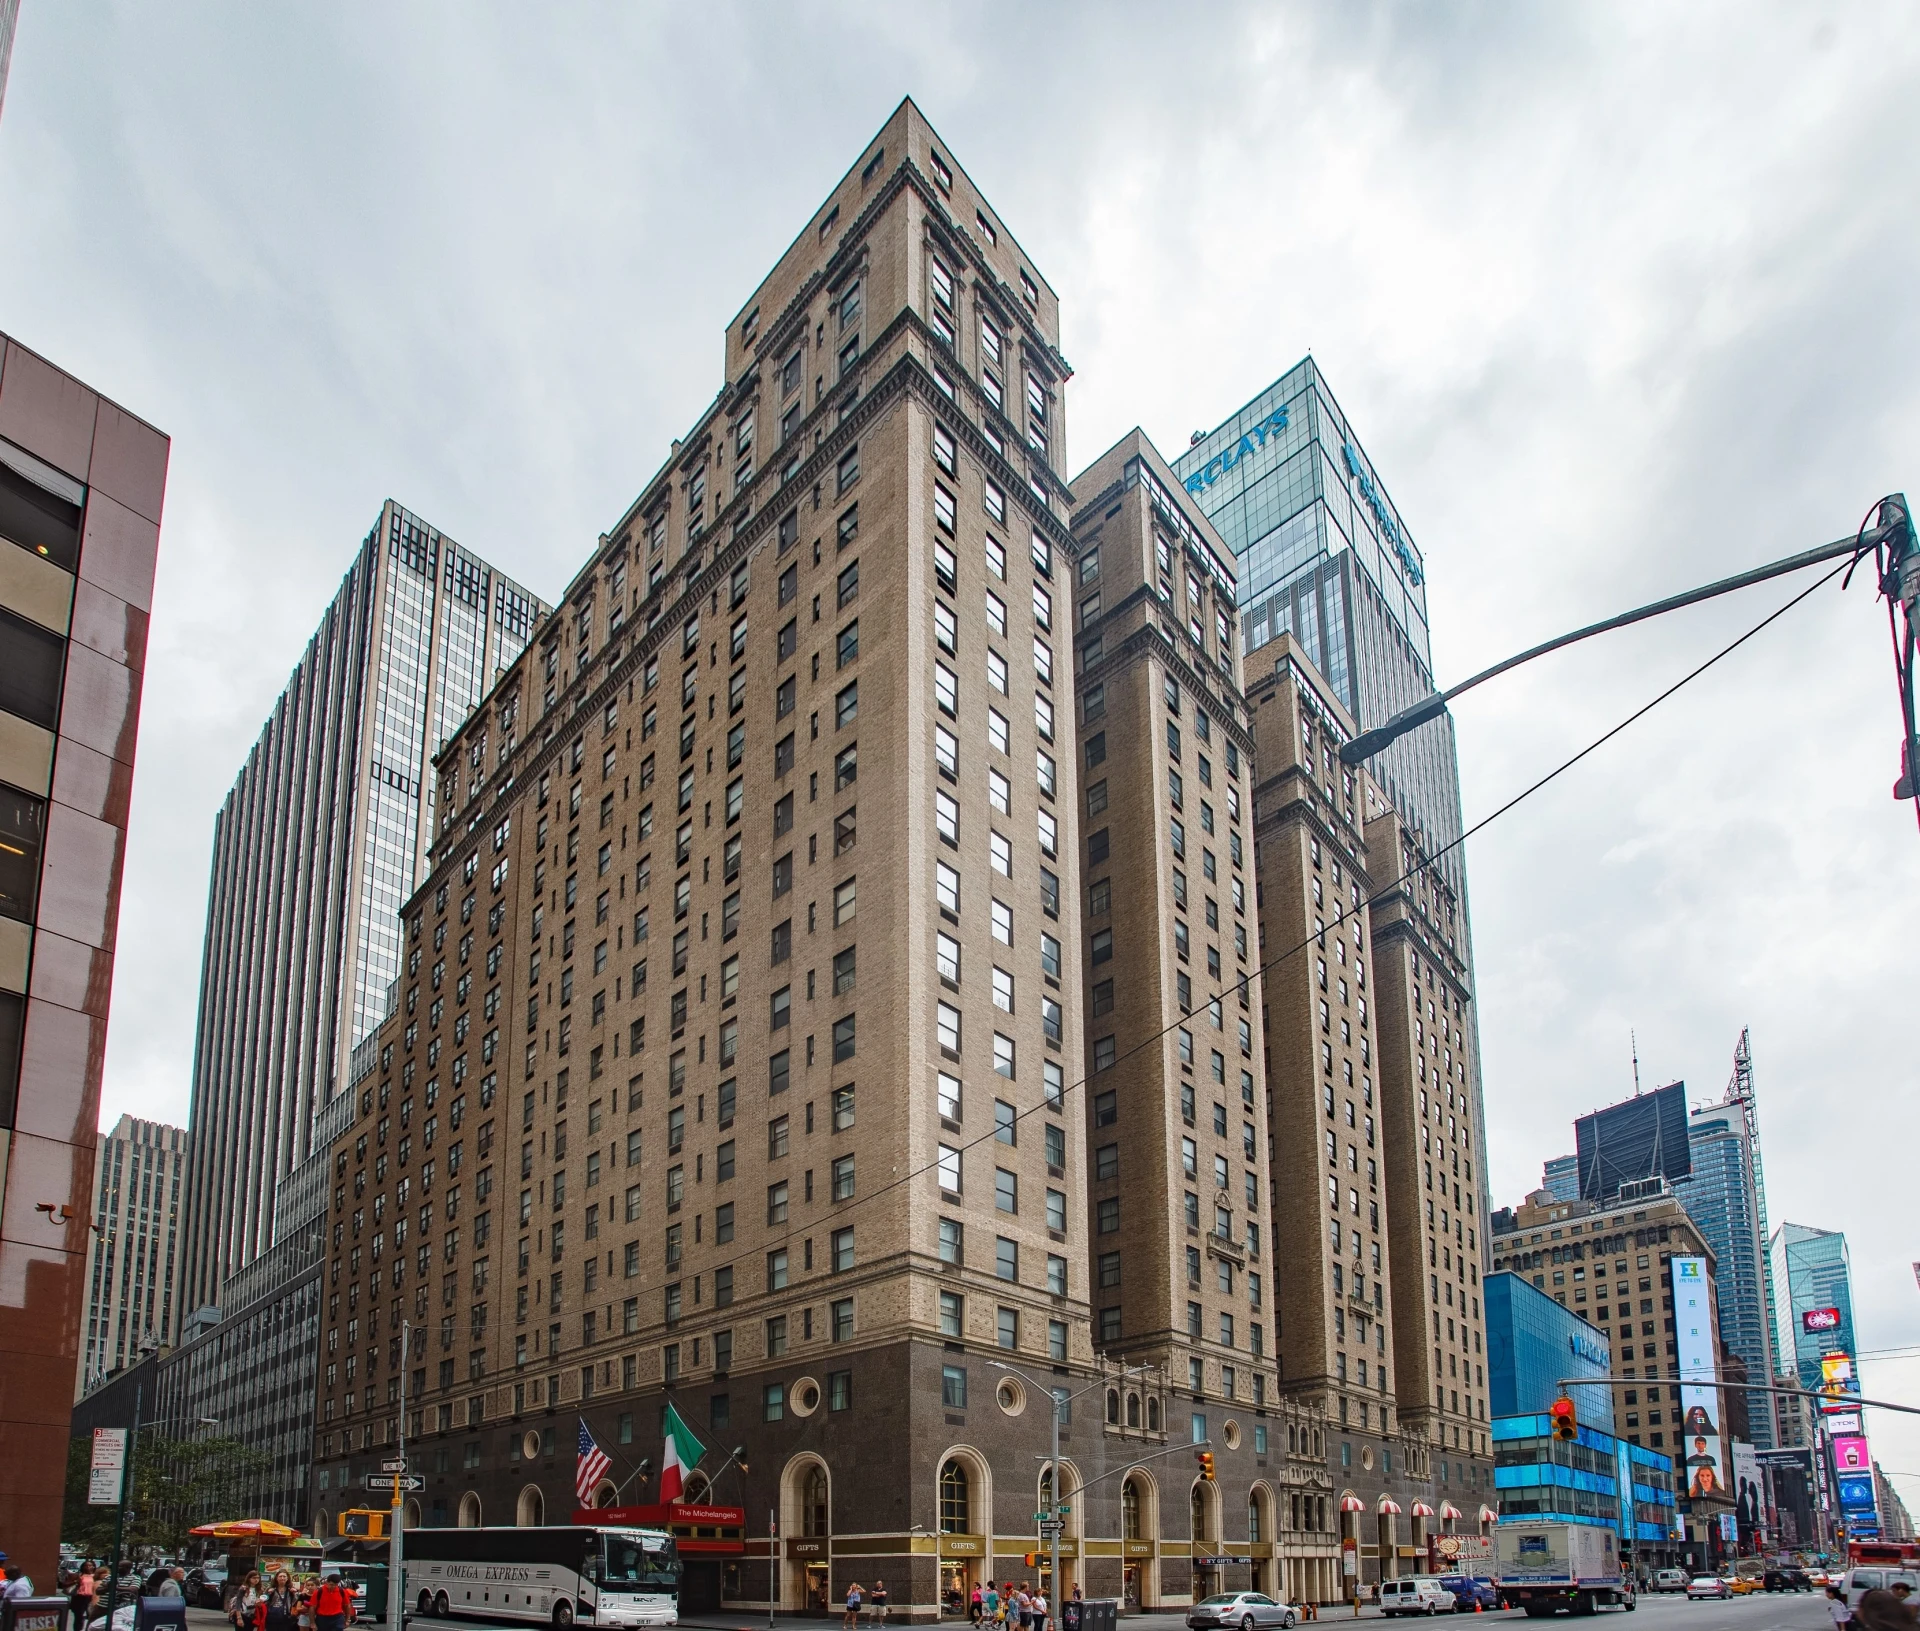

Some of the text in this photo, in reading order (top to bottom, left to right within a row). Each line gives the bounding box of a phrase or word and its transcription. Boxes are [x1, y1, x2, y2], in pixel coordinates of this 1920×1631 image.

[678, 1509, 737, 1520] The Michelangelo
[951, 1542, 976, 1550] GIFTS
[446, 1565, 530, 1581] OMEGA EXPRESS
[18, 1615, 60, 1630] JERSEY
